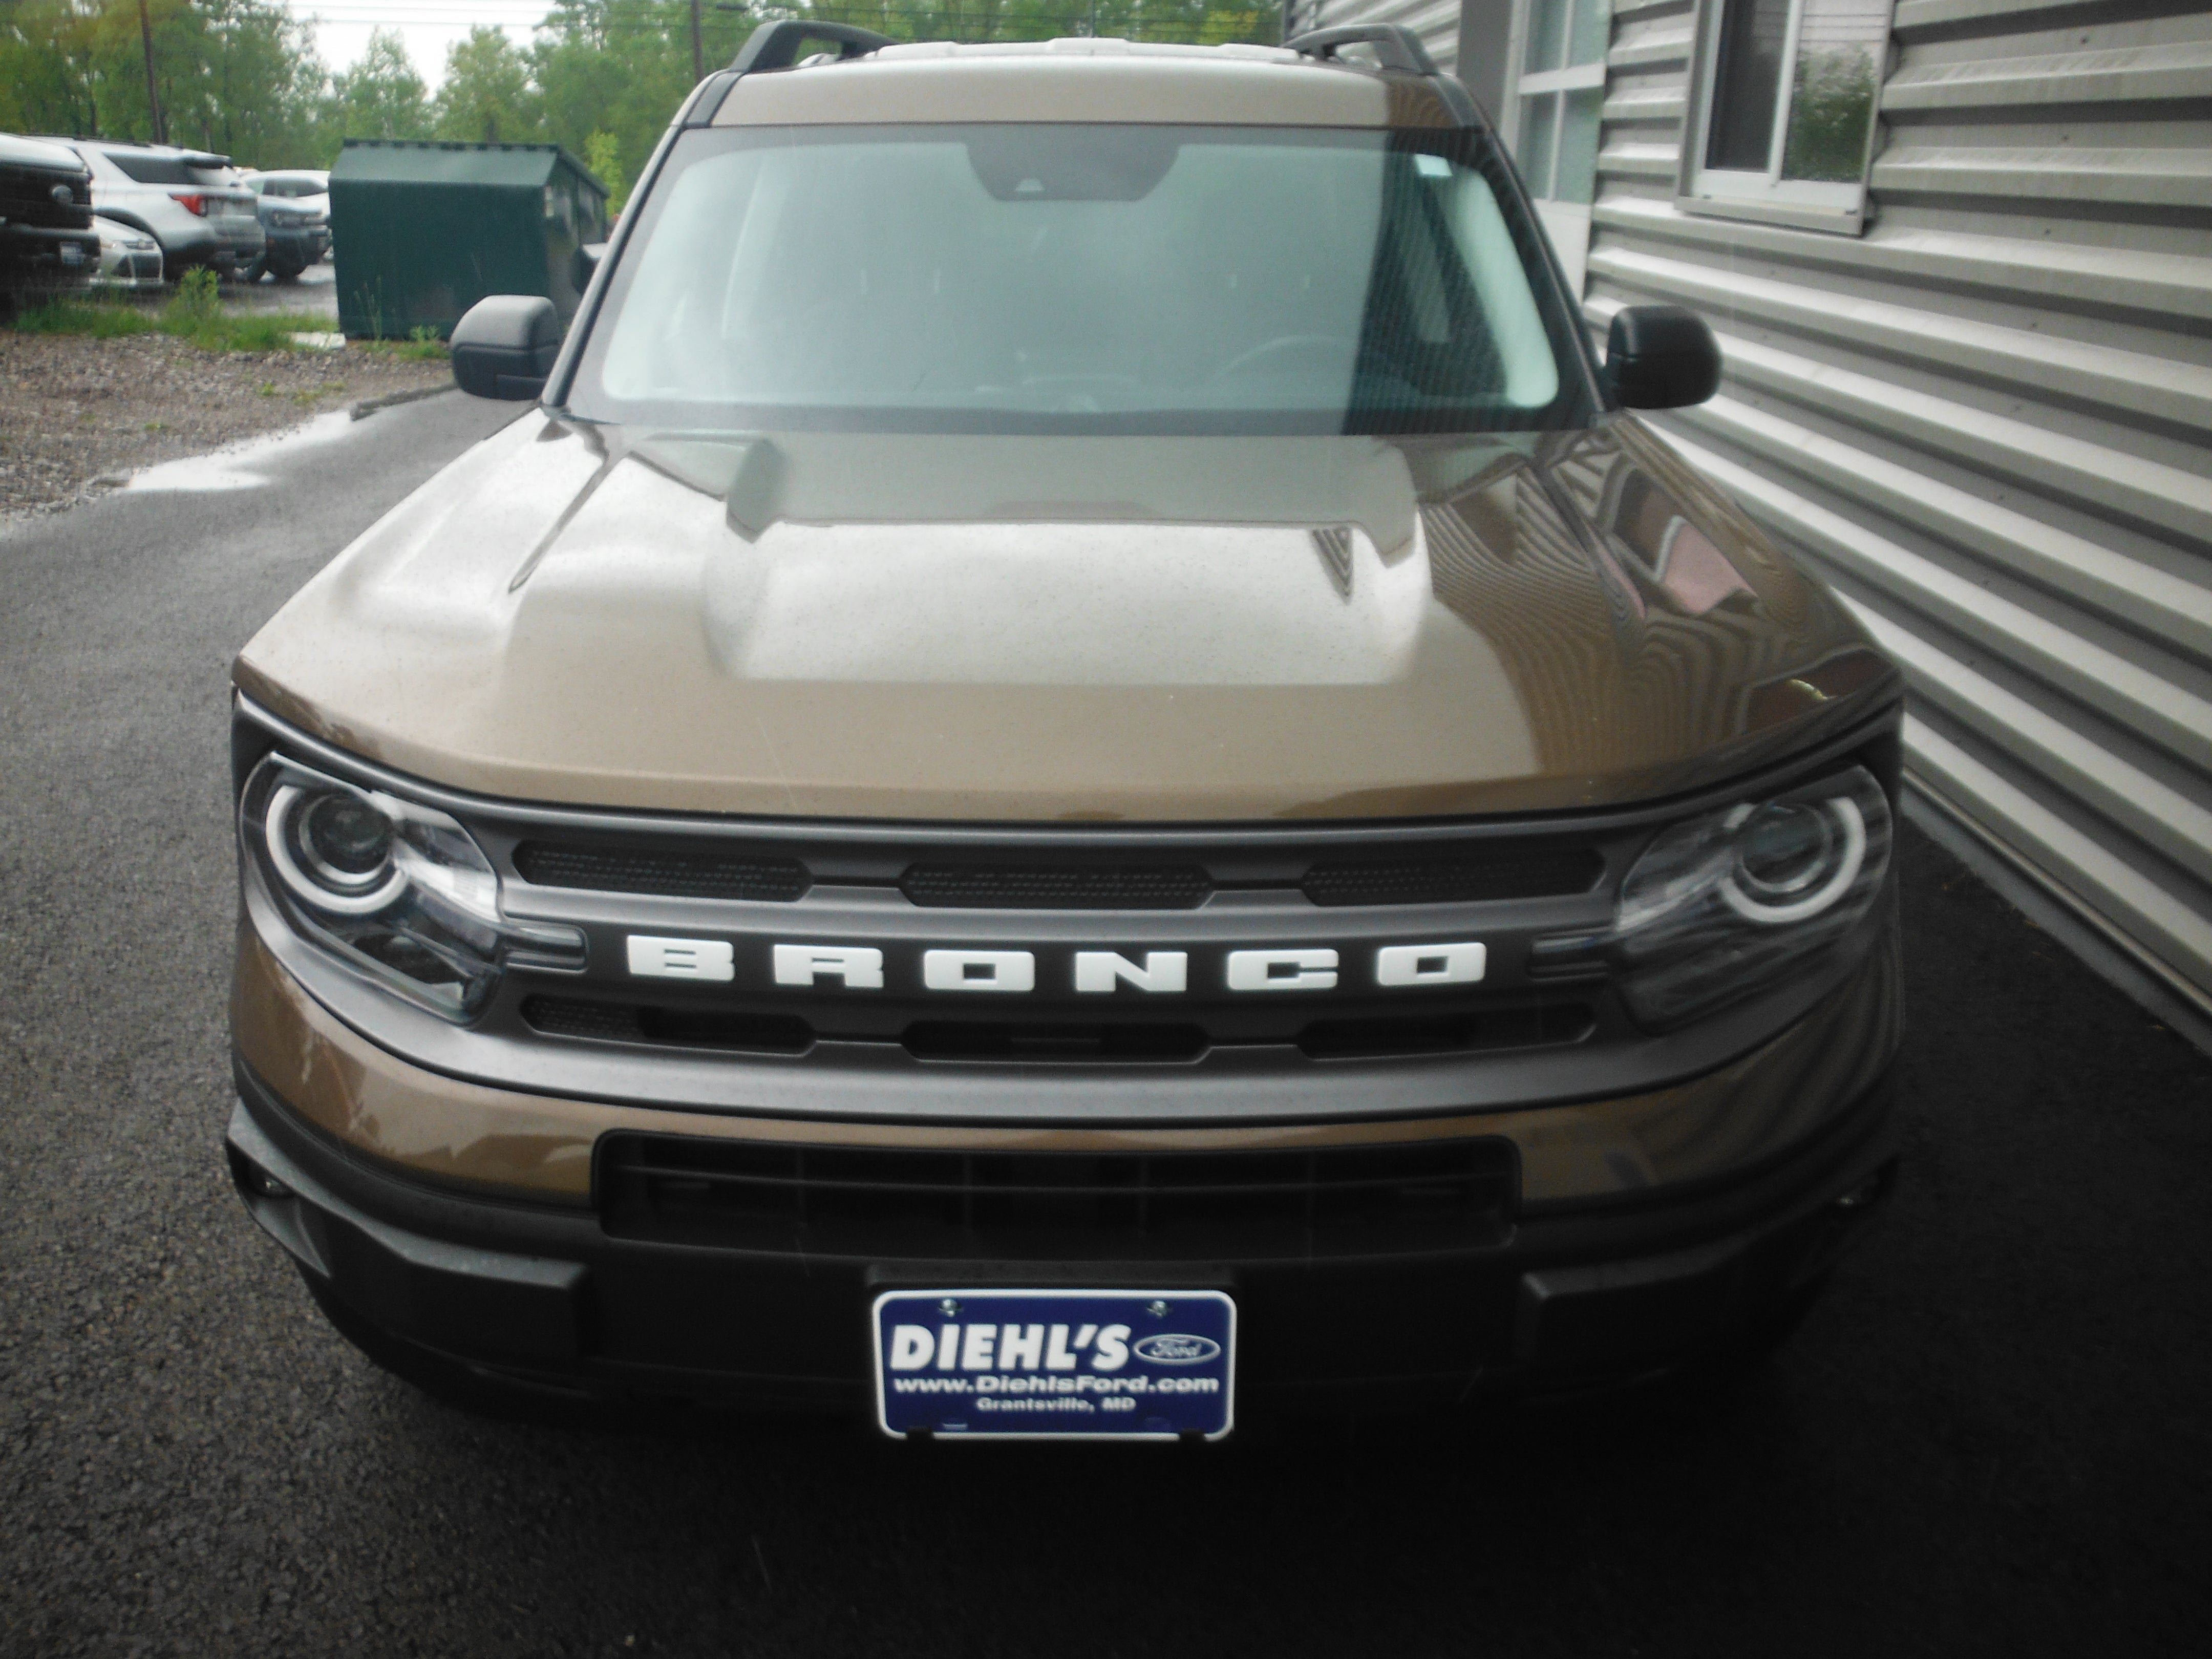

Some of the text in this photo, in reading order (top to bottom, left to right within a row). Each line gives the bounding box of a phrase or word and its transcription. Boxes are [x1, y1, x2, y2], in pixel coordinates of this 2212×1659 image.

[626, 934, 1487, 992] BRONCO
[891, 1324, 1131, 1370] DIEHL'S
[1150, 1337, 1201, 1358] Ford
[893, 1375, 1219, 1393] www.DiehlsFord.com
[1102, 1397, 1136, 1411] MD
